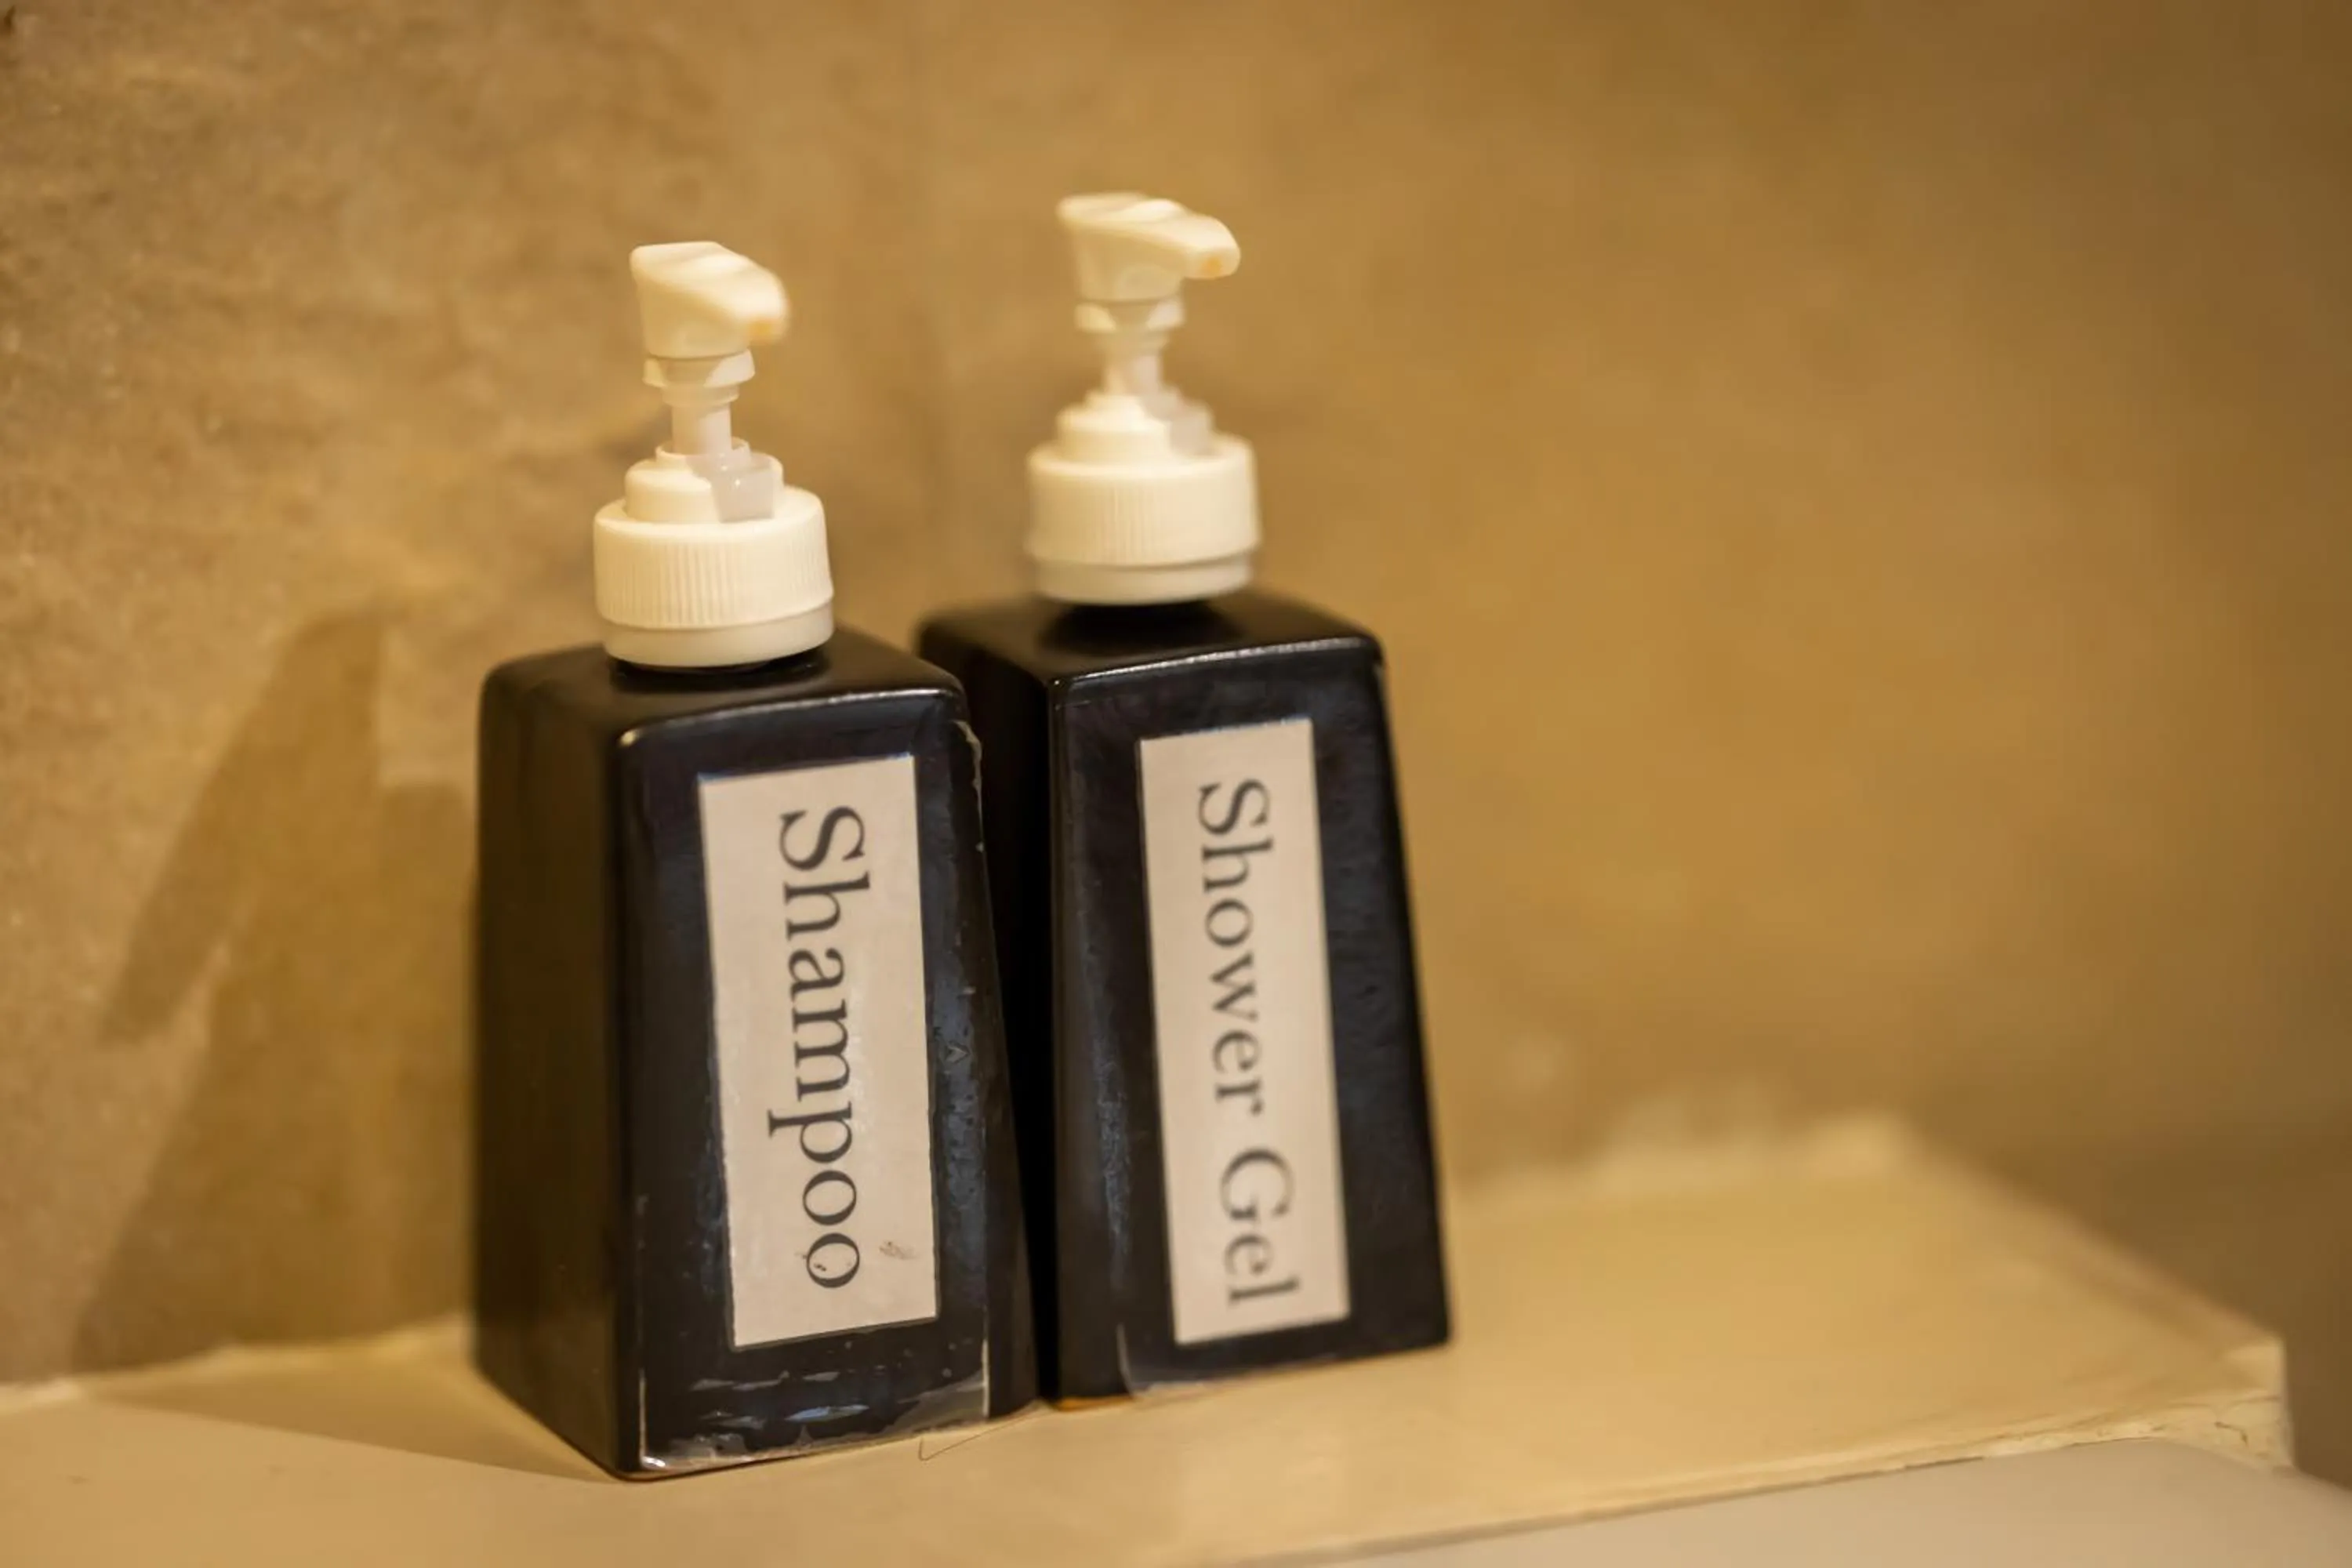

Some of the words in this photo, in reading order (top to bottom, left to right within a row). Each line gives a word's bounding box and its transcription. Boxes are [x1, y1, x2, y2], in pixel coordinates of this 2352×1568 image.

[767, 804, 871, 1290] Shampoo
[1197, 779, 1274, 1116] Shower
[1218, 1148, 1300, 1308] Gel
